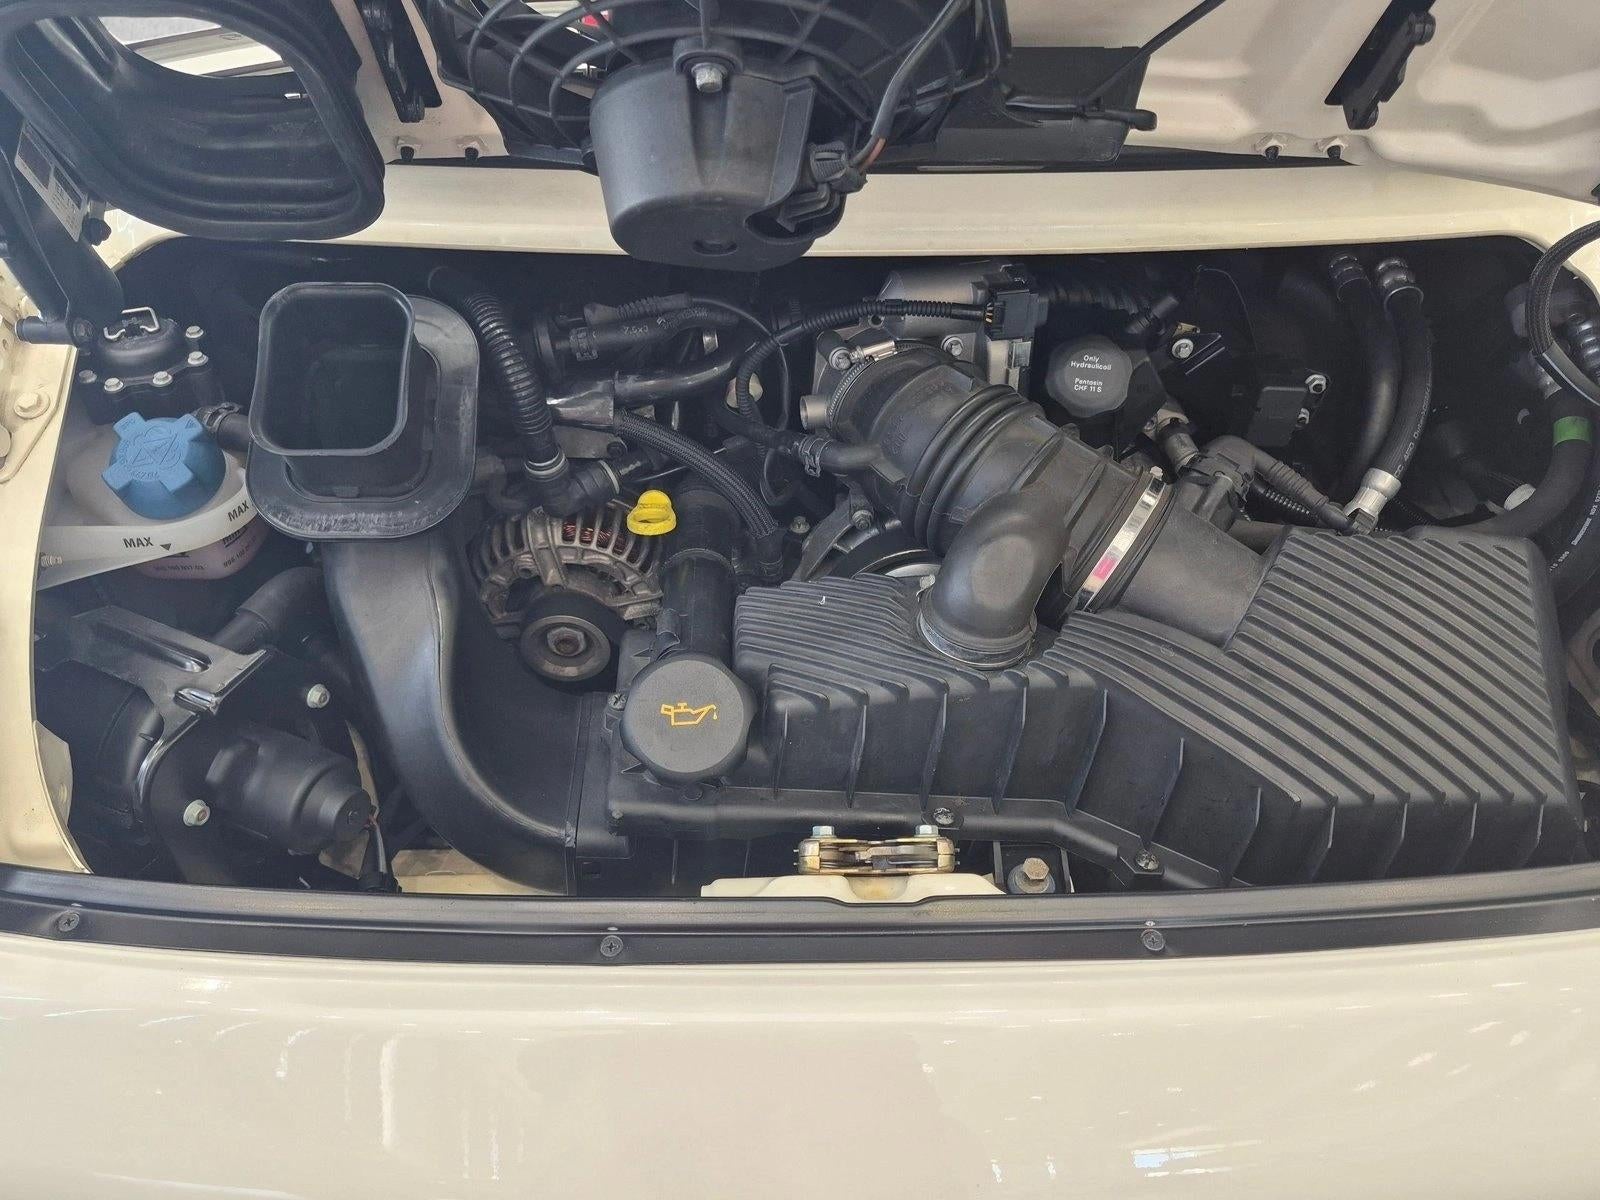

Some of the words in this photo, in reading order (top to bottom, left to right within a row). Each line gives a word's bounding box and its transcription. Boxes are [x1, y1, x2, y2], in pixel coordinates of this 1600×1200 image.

[1070, 360, 1112, 370] Hydraulicoil
[227, 500, 250, 522] MAX
[122, 536, 154, 549] MAX
